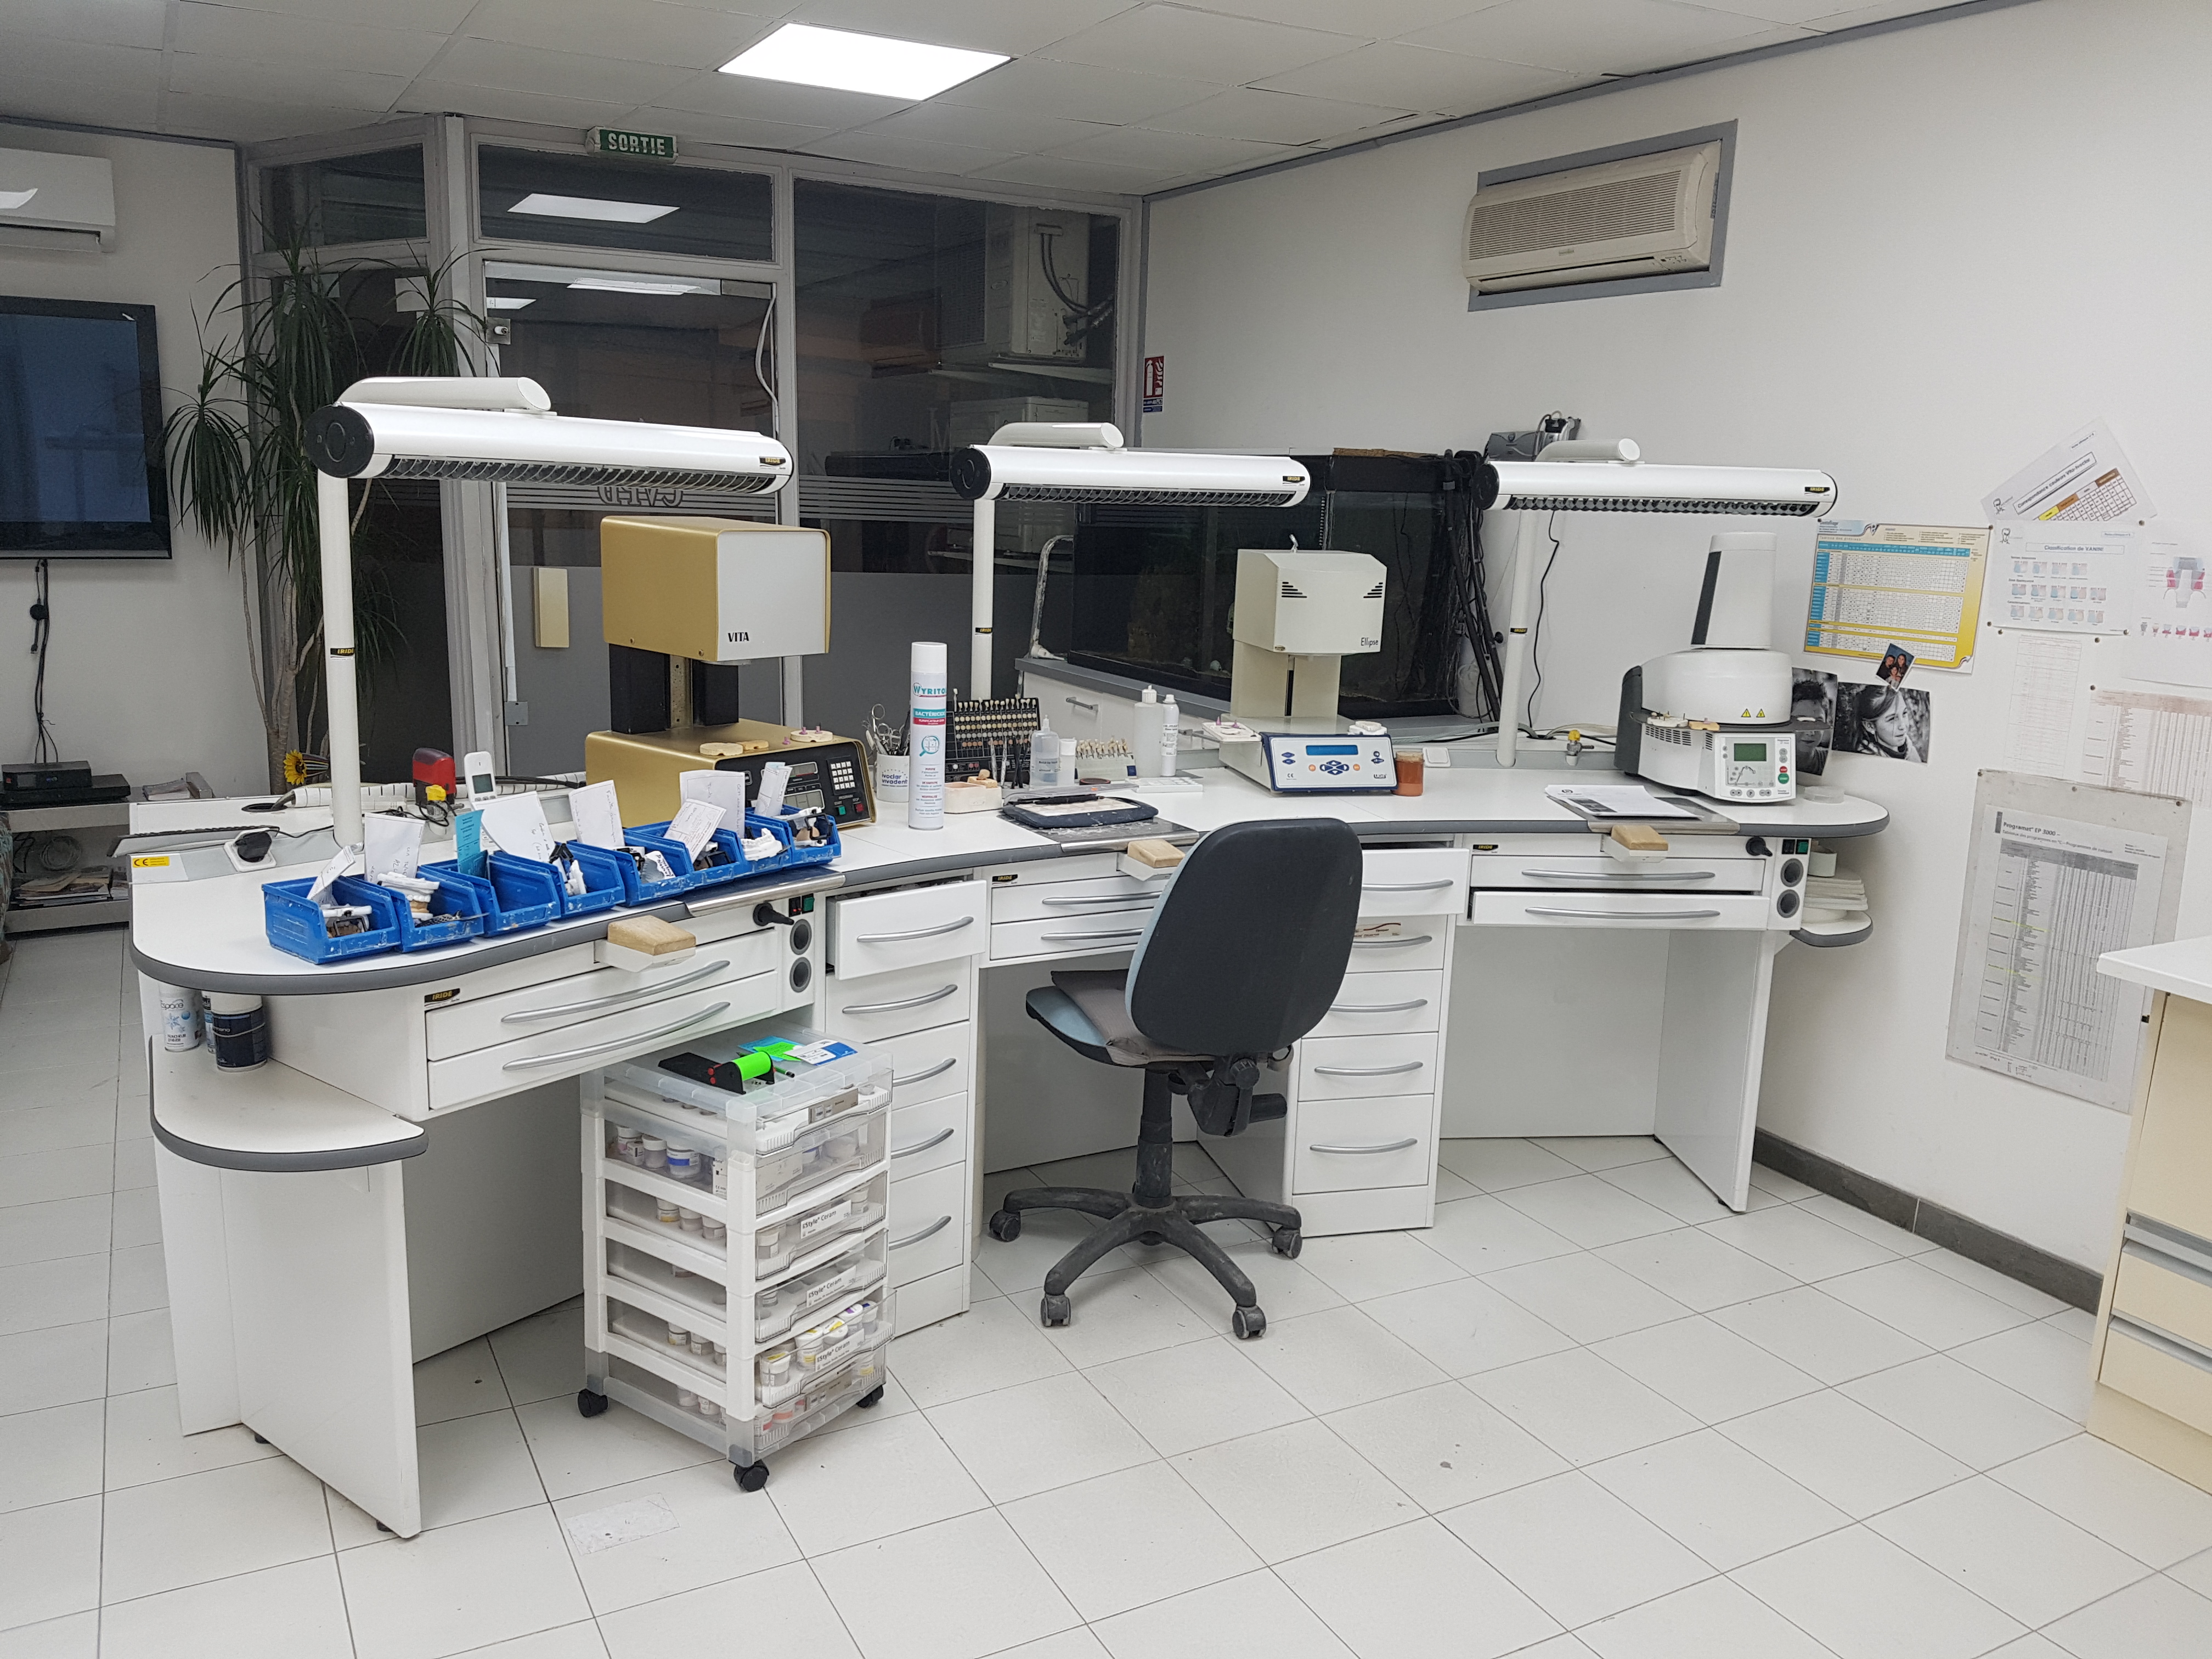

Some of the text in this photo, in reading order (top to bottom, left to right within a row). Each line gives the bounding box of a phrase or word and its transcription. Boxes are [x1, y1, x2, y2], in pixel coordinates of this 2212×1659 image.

[607, 132, 665, 155] SORTIE
[727, 631, 749, 642] VITA
[1361, 637, 1379, 648] Ellipse
[913, 685, 947, 695] WYRITO
[432, 990, 453, 1000] IRIDE
[821, 1210, 837, 1221] Ceram
[826, 1278, 842, 1289] Ceram
[834, 1341, 850, 1352] Ceram
